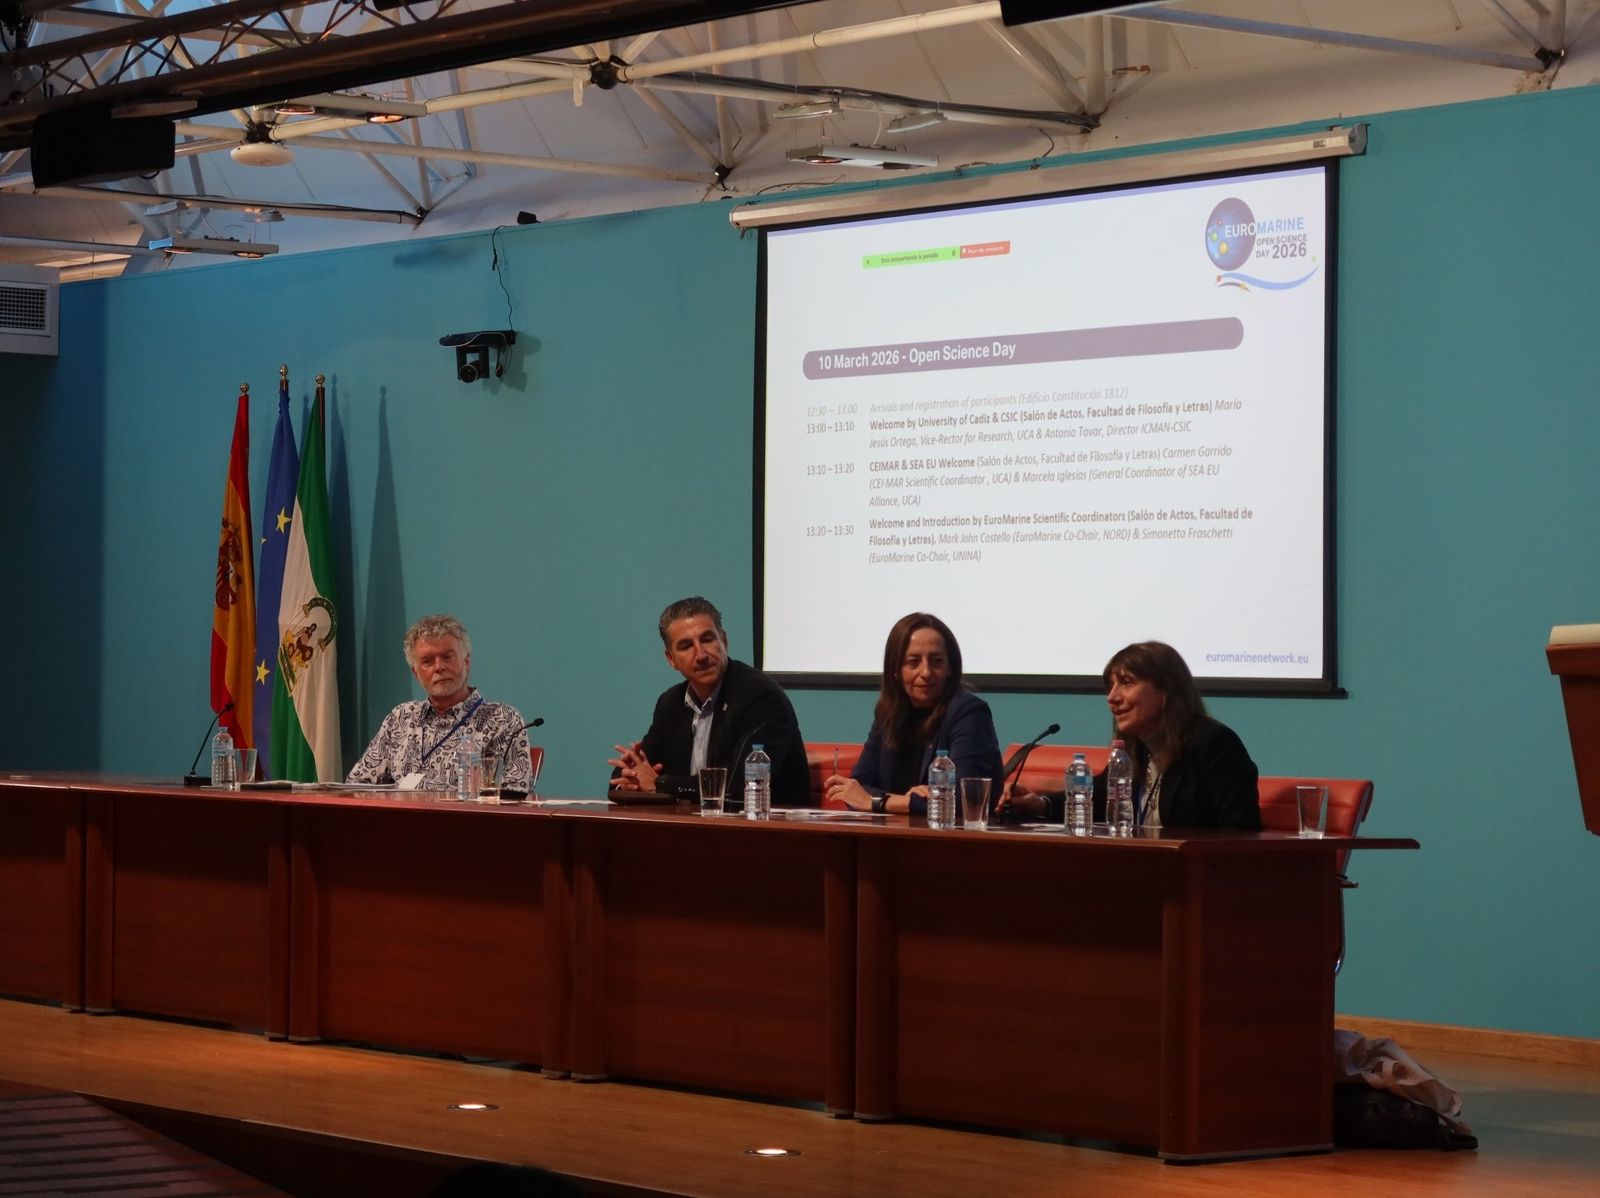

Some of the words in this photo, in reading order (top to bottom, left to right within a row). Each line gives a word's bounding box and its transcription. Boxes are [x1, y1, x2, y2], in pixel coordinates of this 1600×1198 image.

[1256, 237, 1275, 247] OPEN
[1276, 233, 1308, 244] SCIENCE
[1256, 250, 1270, 259] DAY
[1271, 242, 1307, 259] 2026
[817, 356, 831, 370] 10
[834, 354, 869, 369] March
[871, 350, 899, 366] 2026
[909, 348, 940, 366] Open
[942, 344, 990, 361] Science
[992, 342, 1016, 359] Day
[869, 401, 897, 413] Arrivals
[899, 400, 914, 411] and
[915, 395, 959, 412] registration
[960, 396, 971, 409] of
[970, 394, 1016, 409] participants
[1104, 386, 1128, 401] 1812)
[807, 405, 827, 417] 12:30
[837, 403, 857, 415] 13:00
[869, 419, 905, 431] Welcome
[907, 418, 916, 430] by
[918, 415, 957, 427] University
[959, 414, 968, 425] of
[992, 412, 999, 423] &
[1001, 412, 1018, 422] CSIC
[1020, 410, 1045, 424] (Salón
[1047, 409, 1058, 420] de
[1059, 408, 1085, 419] Actos,
[1086, 406, 1123, 418] Facultad
[1125, 404, 1136, 415] de
[1175, 404, 1180, 415] y
[1182, 400, 1212, 413] Letras)
[807, 422, 826, 434] 13:00
[834, 420, 854, 432] 13:10
[890, 436, 918, 448] Ortega,
[921, 433, 965, 446] Vice-Rector
[963, 432, 976, 445] for
[978, 430, 1014, 443] Research,
[1017, 429, 1034, 440] UCA
[1036, 428, 1043, 440] &
[1044, 426, 1076, 439] Antonio
[1079, 426, 1104, 438] Tovar,
[1106, 424, 1139, 436] Director
[1141, 420, 1192, 434] ICMAN-CSIC
[869, 461, 900, 472] CEIMAR
[901, 459, 908, 471] &
[909, 459, 924, 470] SEA
[926, 458, 936, 469] EU
[938, 457, 975, 468] Welcome
[1002, 455, 1013, 465] de
[1014, 454, 1039, 466] Actos,
[1040, 452, 1075, 464] Facultad
[1077, 451, 1088, 462] de
[1125, 451, 1130, 462] y
[1131, 448, 1160, 461] Letras)
[1162, 447, 1195, 458] Carmen
[1198, 444, 1232, 457] Garrido
[807, 464, 826, 476] 13:10
[834, 462, 854, 474] 13:20
[905, 475, 938, 488] Scientific
[940, 472, 985, 486] Coordinator
[992, 470, 1011, 484] UCA)
[1013, 471, 1020, 482] &
[1022, 470, 1055, 482] Marcela
[1057, 469, 1086, 483] Iglesias
[1089, 467, 1123, 481] (General
[1125, 465, 1175, 479] Coordinator
[1177, 464, 1187, 479] of
[1188, 464, 1204, 476] SEA
[1207, 464, 1220, 475] EU
[869, 496, 900, 507] Alliance,
[902, 494, 921, 507] UCA)
[869, 518, 905, 529] Welcome
[906, 516, 920, 527] and
[922, 515, 971, 527] Introduction
[972, 514, 982, 527] by
[984, 513, 1031, 525] EuroMarine
[1033, 512, 1070, 524] Scientific
[1071, 510, 1126, 522] Coordinators
[1127, 509, 1154, 523] (Salón
[1156, 509, 1168, 520] de
[1169, 509, 1197, 521] Actos,
[1199, 507, 1239, 519] Facultad
[1241, 507, 1253, 519] de
[806, 526, 826, 536] 13:20
[834, 525, 854, 536] 13:30
[902, 536, 907, 547] y
[938, 533, 959, 544] Mark
[960, 532, 978, 544] John
[980, 531, 1011, 543] Costello
[1012, 529, 1063, 544] (EuroMarine
[1064, 529, 1101, 542] Co-Chair,
[1103, 528, 1131, 542] NORD)
[1132, 527, 1140, 539] &
[1141, 528, 1186, 540] Simonetta
[1187, 526, 1233, 539] Fraschetti
[869, 551, 915, 564] (EuroMarine
[916, 550, 950, 563] Co-Chair,
[952, 550, 981, 563] UNINA)
[1205, 651, 1309, 664] euromarinenetwork.eu
